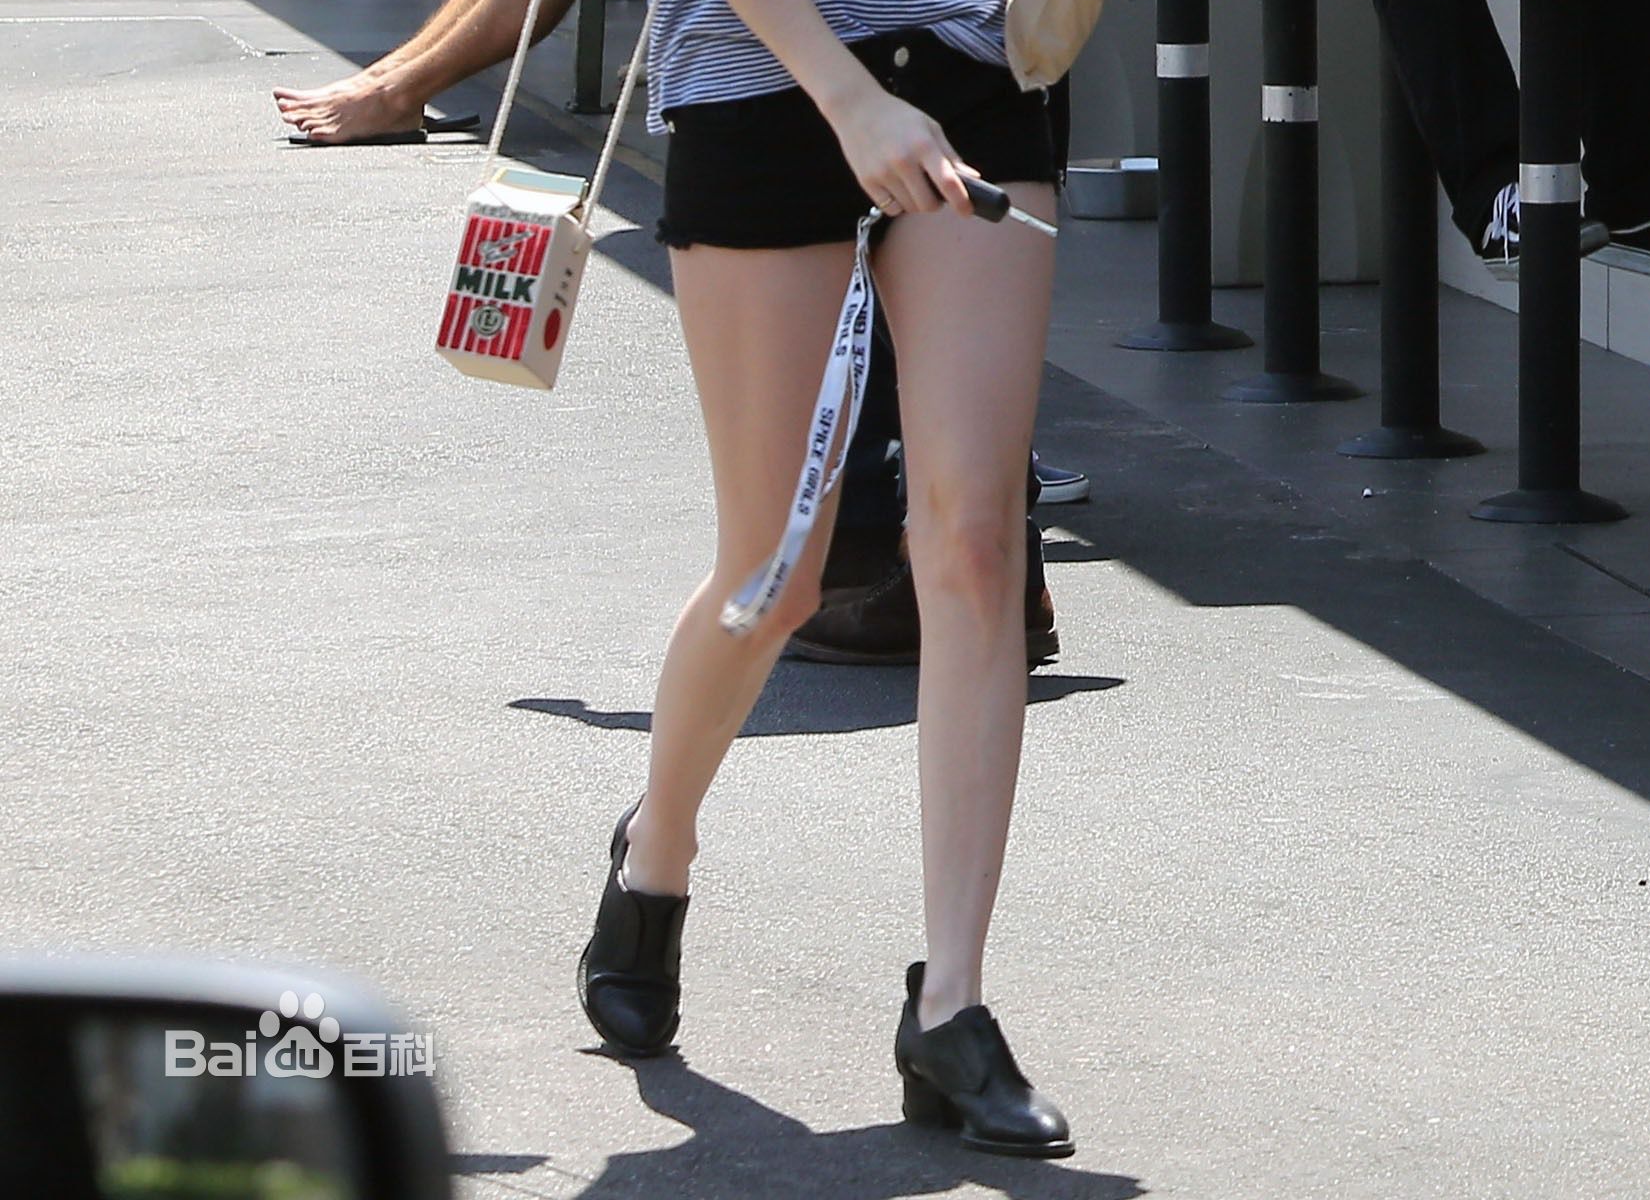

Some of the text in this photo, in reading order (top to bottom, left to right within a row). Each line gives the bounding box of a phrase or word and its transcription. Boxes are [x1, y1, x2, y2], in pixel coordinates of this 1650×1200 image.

[456, 267, 537, 303] MILK
[798, 406, 835, 516] SPICE GIRLS
